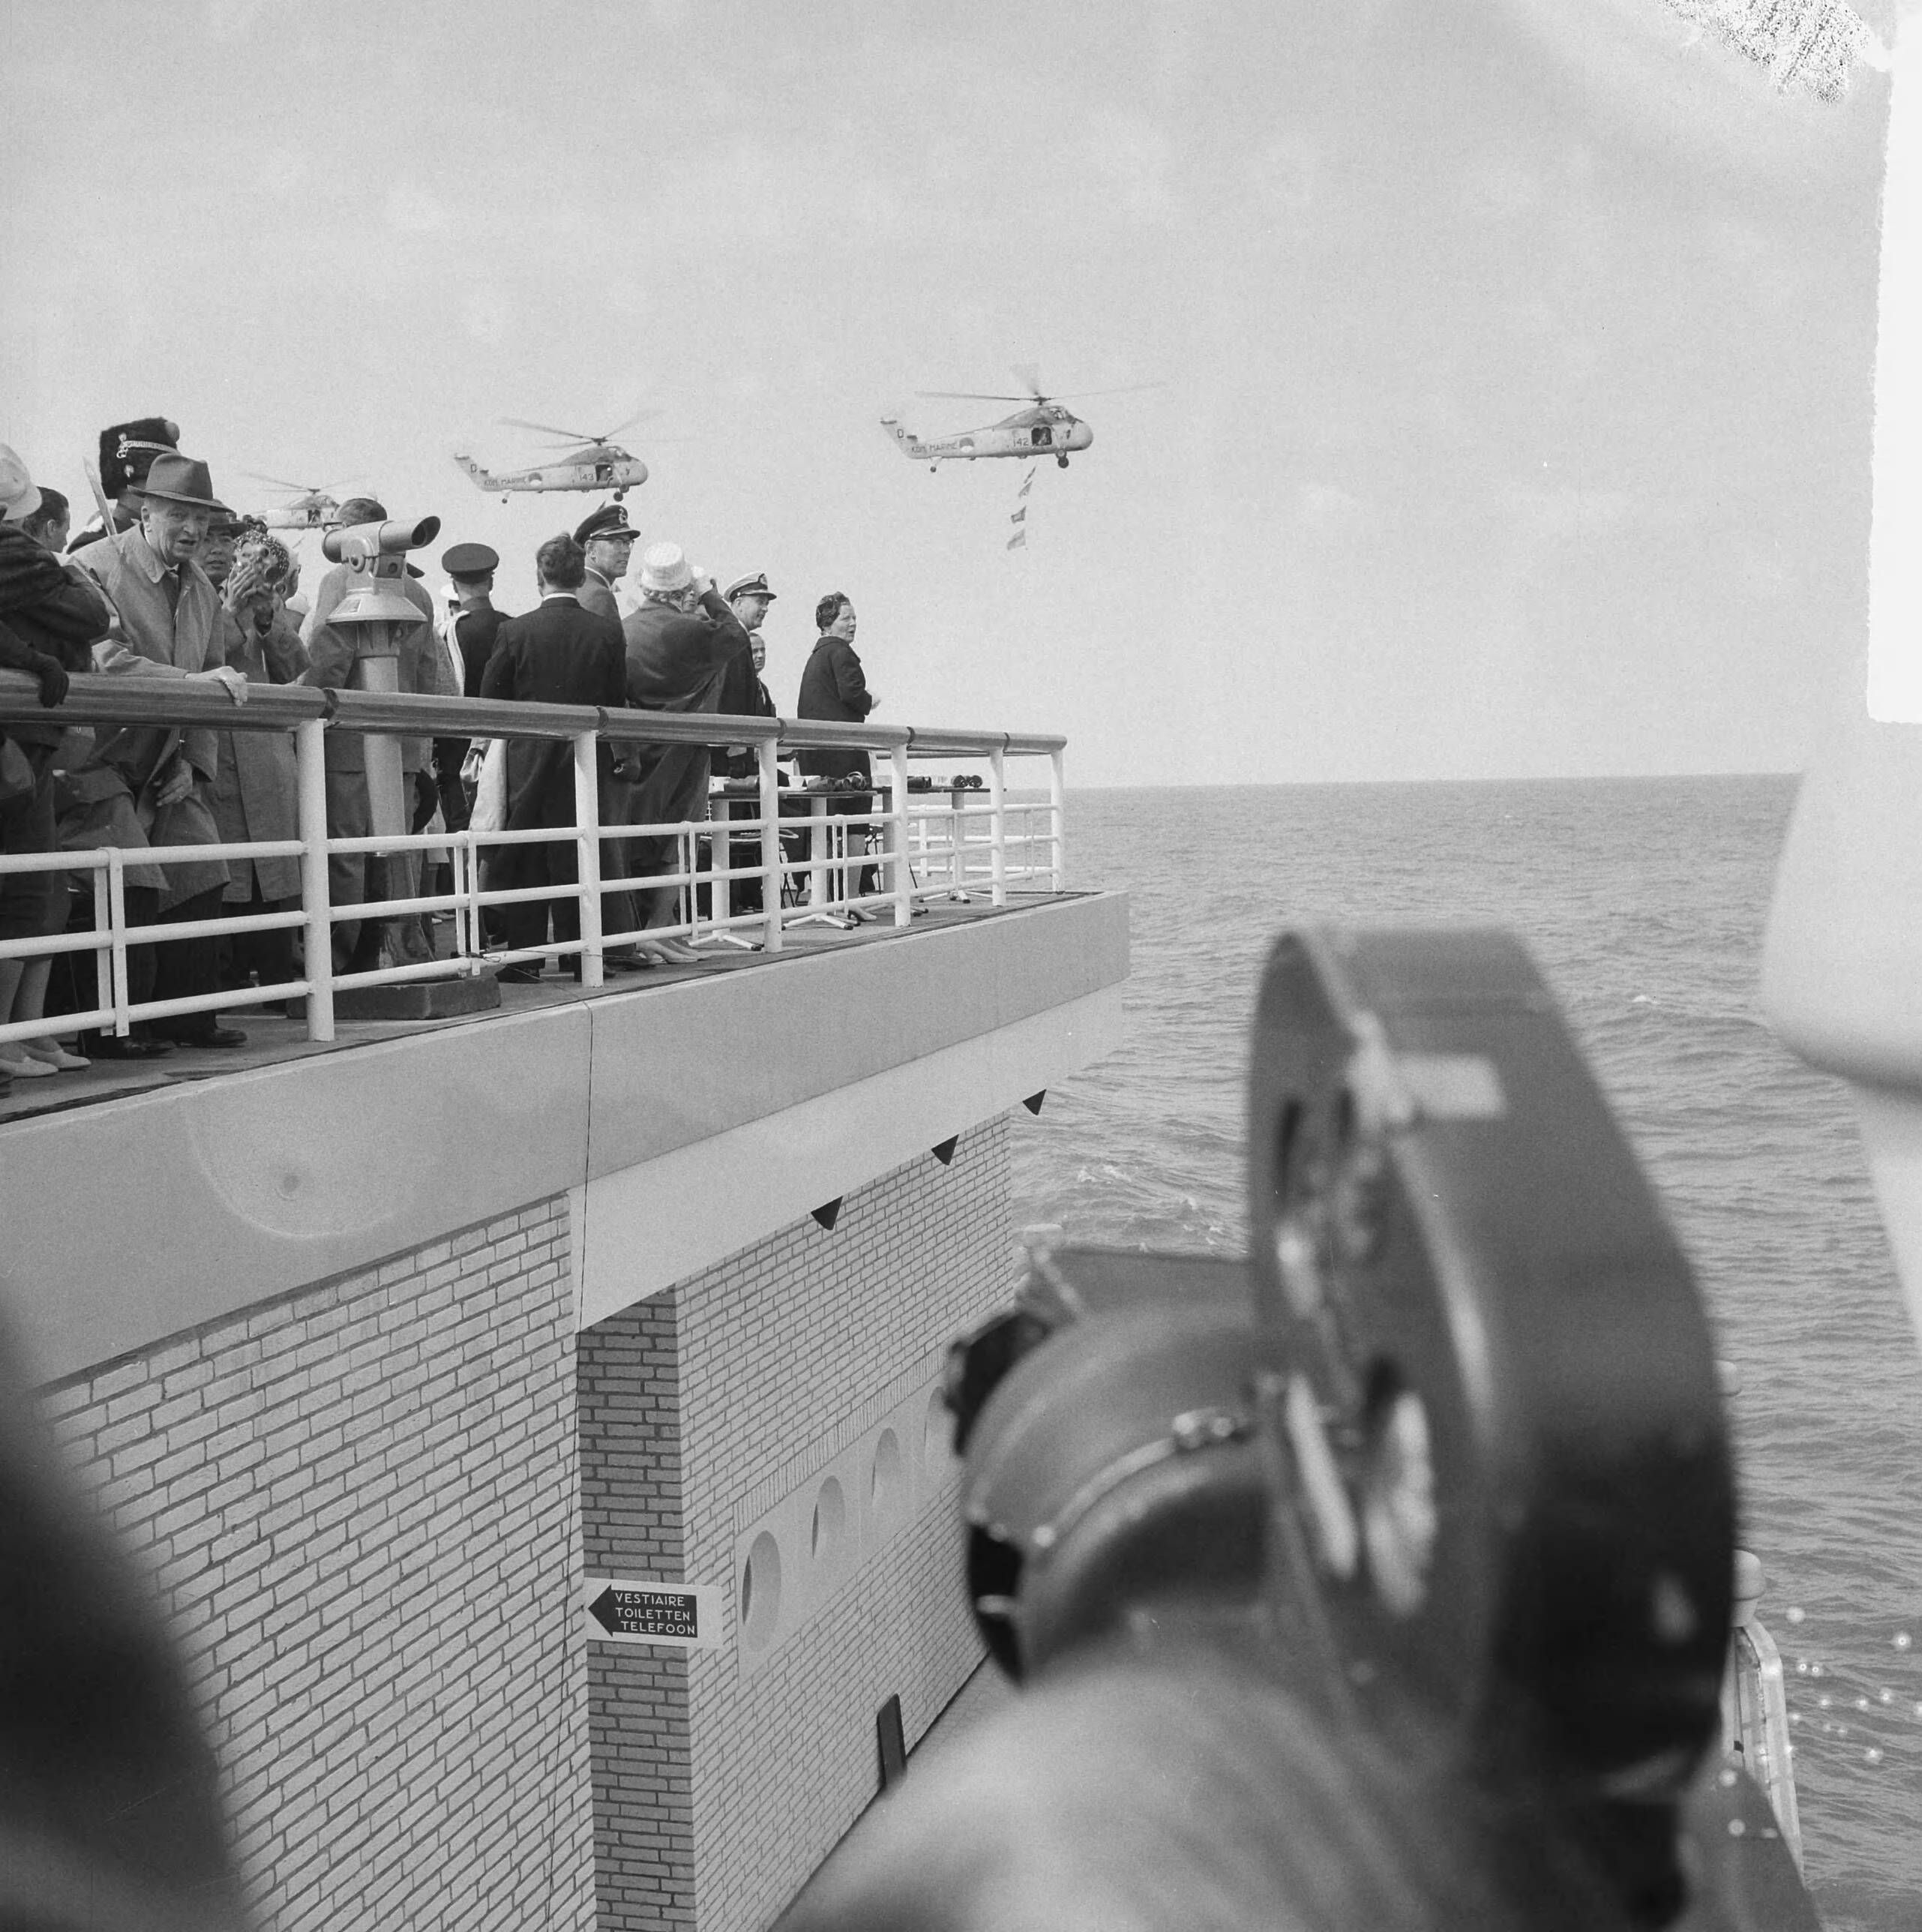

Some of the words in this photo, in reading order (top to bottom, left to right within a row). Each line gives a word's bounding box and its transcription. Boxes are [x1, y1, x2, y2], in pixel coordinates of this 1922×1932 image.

[1012, 436, 1029, 447] 142
[470, 464, 477, 473] D
[579, 473, 595, 482] 143
[615, 1592, 685, 1606] VESTIAIRE
[615, 1607, 691, 1621] TOILETTEN
[620, 1621, 696, 1635] TELEFOON
